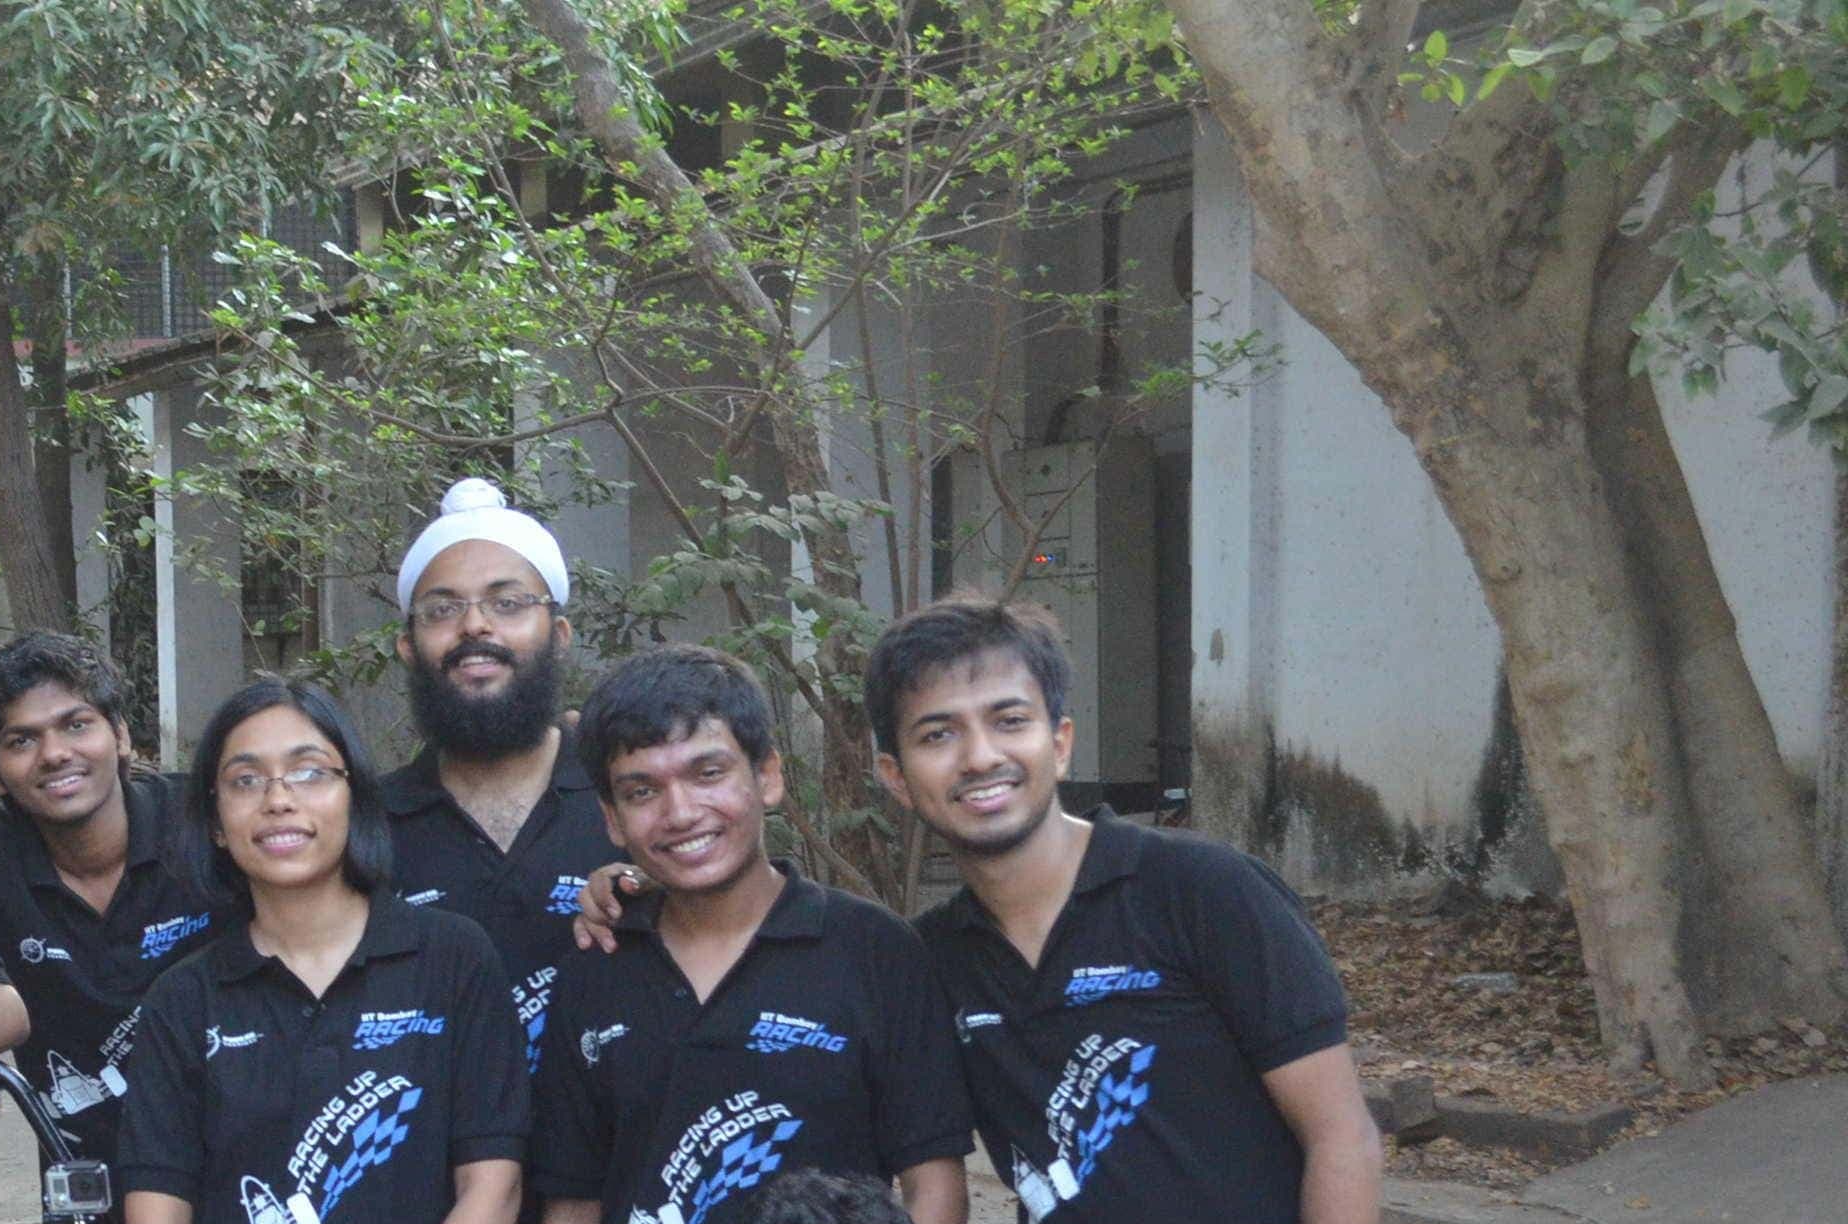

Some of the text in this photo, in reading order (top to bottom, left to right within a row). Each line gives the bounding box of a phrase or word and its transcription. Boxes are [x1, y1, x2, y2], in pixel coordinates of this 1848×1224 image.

[527, 967, 558, 989] UP
[107, 1043, 133, 1067] THE
[1046, 1033, 1103, 1143] RACING UP
[1058, 1037, 1142, 1160] THE LADDER
[288, 1070, 377, 1178] RACING UP
[297, 1075, 412, 1194] THE LADDER
[658, 1091, 759, 1187] RACING UP
[668, 1103, 792, 1206] THE LADDER
